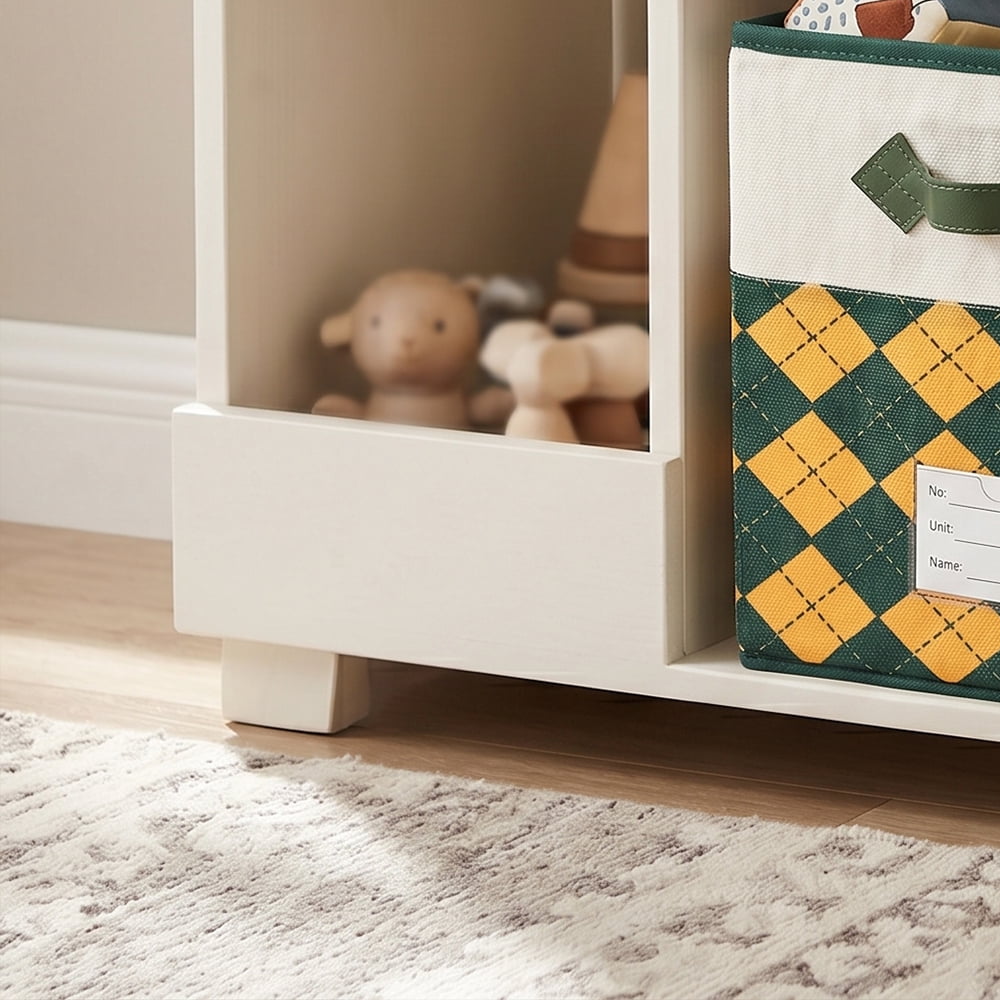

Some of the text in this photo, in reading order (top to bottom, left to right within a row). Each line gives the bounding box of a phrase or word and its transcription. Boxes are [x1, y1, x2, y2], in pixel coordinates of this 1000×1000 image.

[928, 484, 947, 498] No:
[929, 519, 954, 534] Unit:
[929, 556, 963, 572] Name:
